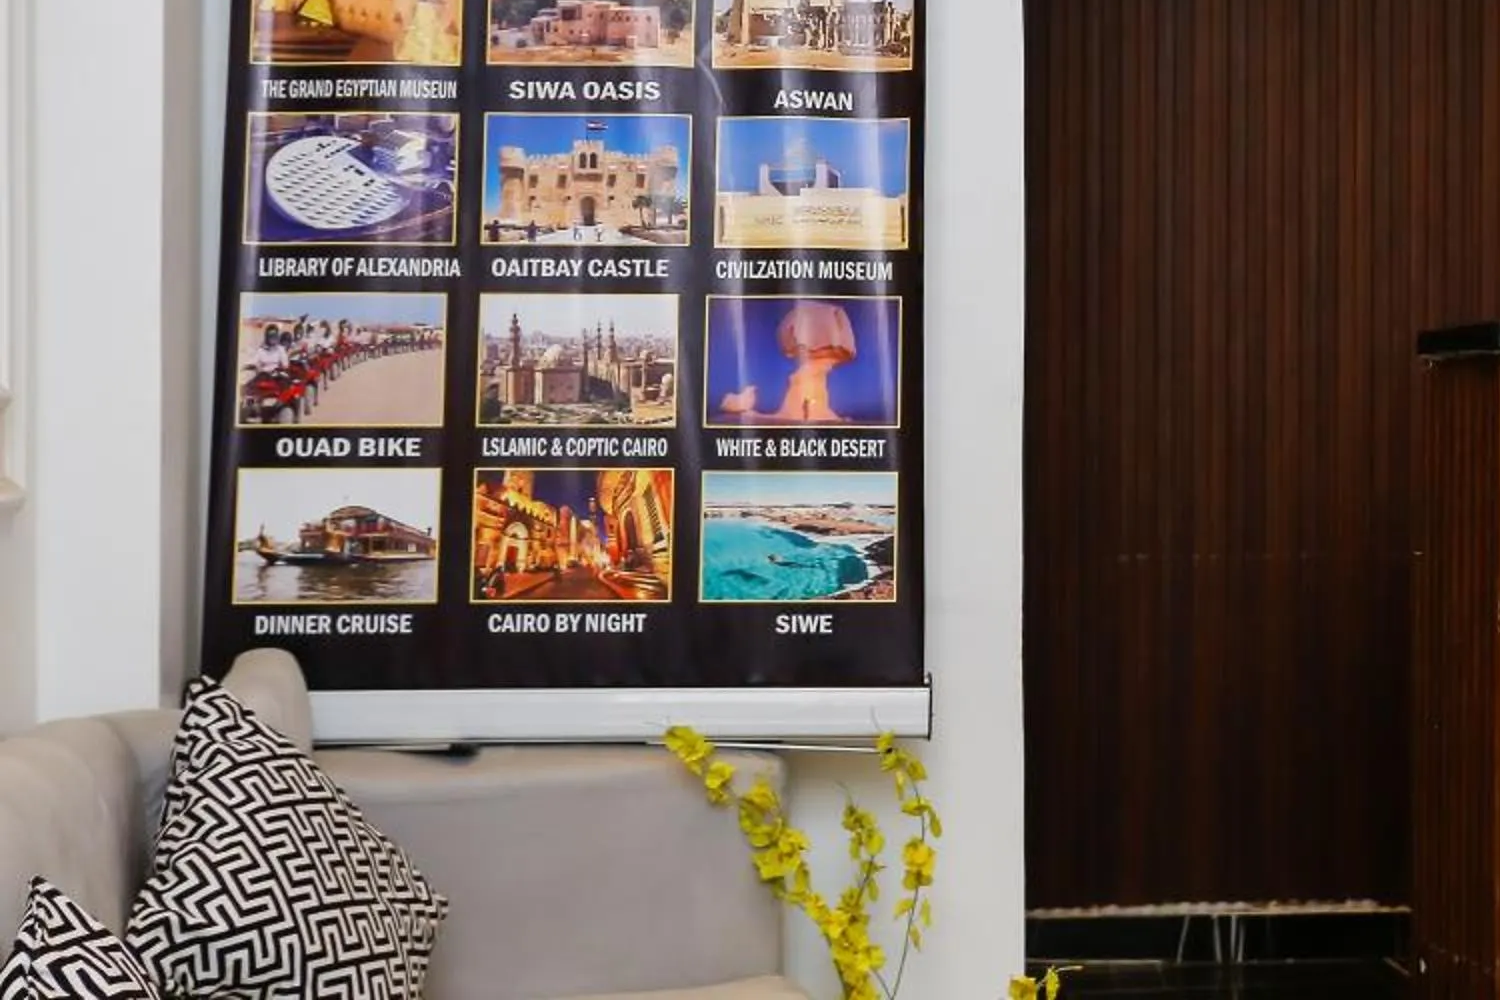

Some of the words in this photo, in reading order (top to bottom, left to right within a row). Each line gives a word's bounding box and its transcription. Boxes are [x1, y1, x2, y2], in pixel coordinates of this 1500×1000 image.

[262, 80, 281, 99] THE
[281, 79, 334, 99] GRAND
[335, 79, 398, 98] EGYPTIAN
[509, 80, 577, 100] SIWA
[582, 81, 661, 101] OASIS
[774, 89, 853, 111] ASWAN
[258, 257, 329, 277] LIBRARY
[331, 257, 355, 277] OF
[356, 257, 461, 277] ALEXANDRIA
[587, 258, 671, 278] CASTLE
[716, 260, 814, 281] CIVILZATION
[818, 258, 893, 284] MUSEUM
[358, 437, 421, 457] BIKE
[550, 437, 563, 457] &
[565, 437, 619, 457] COPTIC
[622, 437, 668, 457] CAIRO
[716, 438, 762, 457] WHITE
[764, 438, 777, 457] &
[780, 438, 827, 457] BLACK
[831, 438, 886, 458] DESERT
[255, 614, 332, 635] DINNER
[336, 614, 413, 634] CRUISE
[488, 613, 551, 633] CAIRO
[555, 613, 582, 633] BY
[585, 613, 647, 633] NIGHT
[775, 614, 833, 634] SIWE
